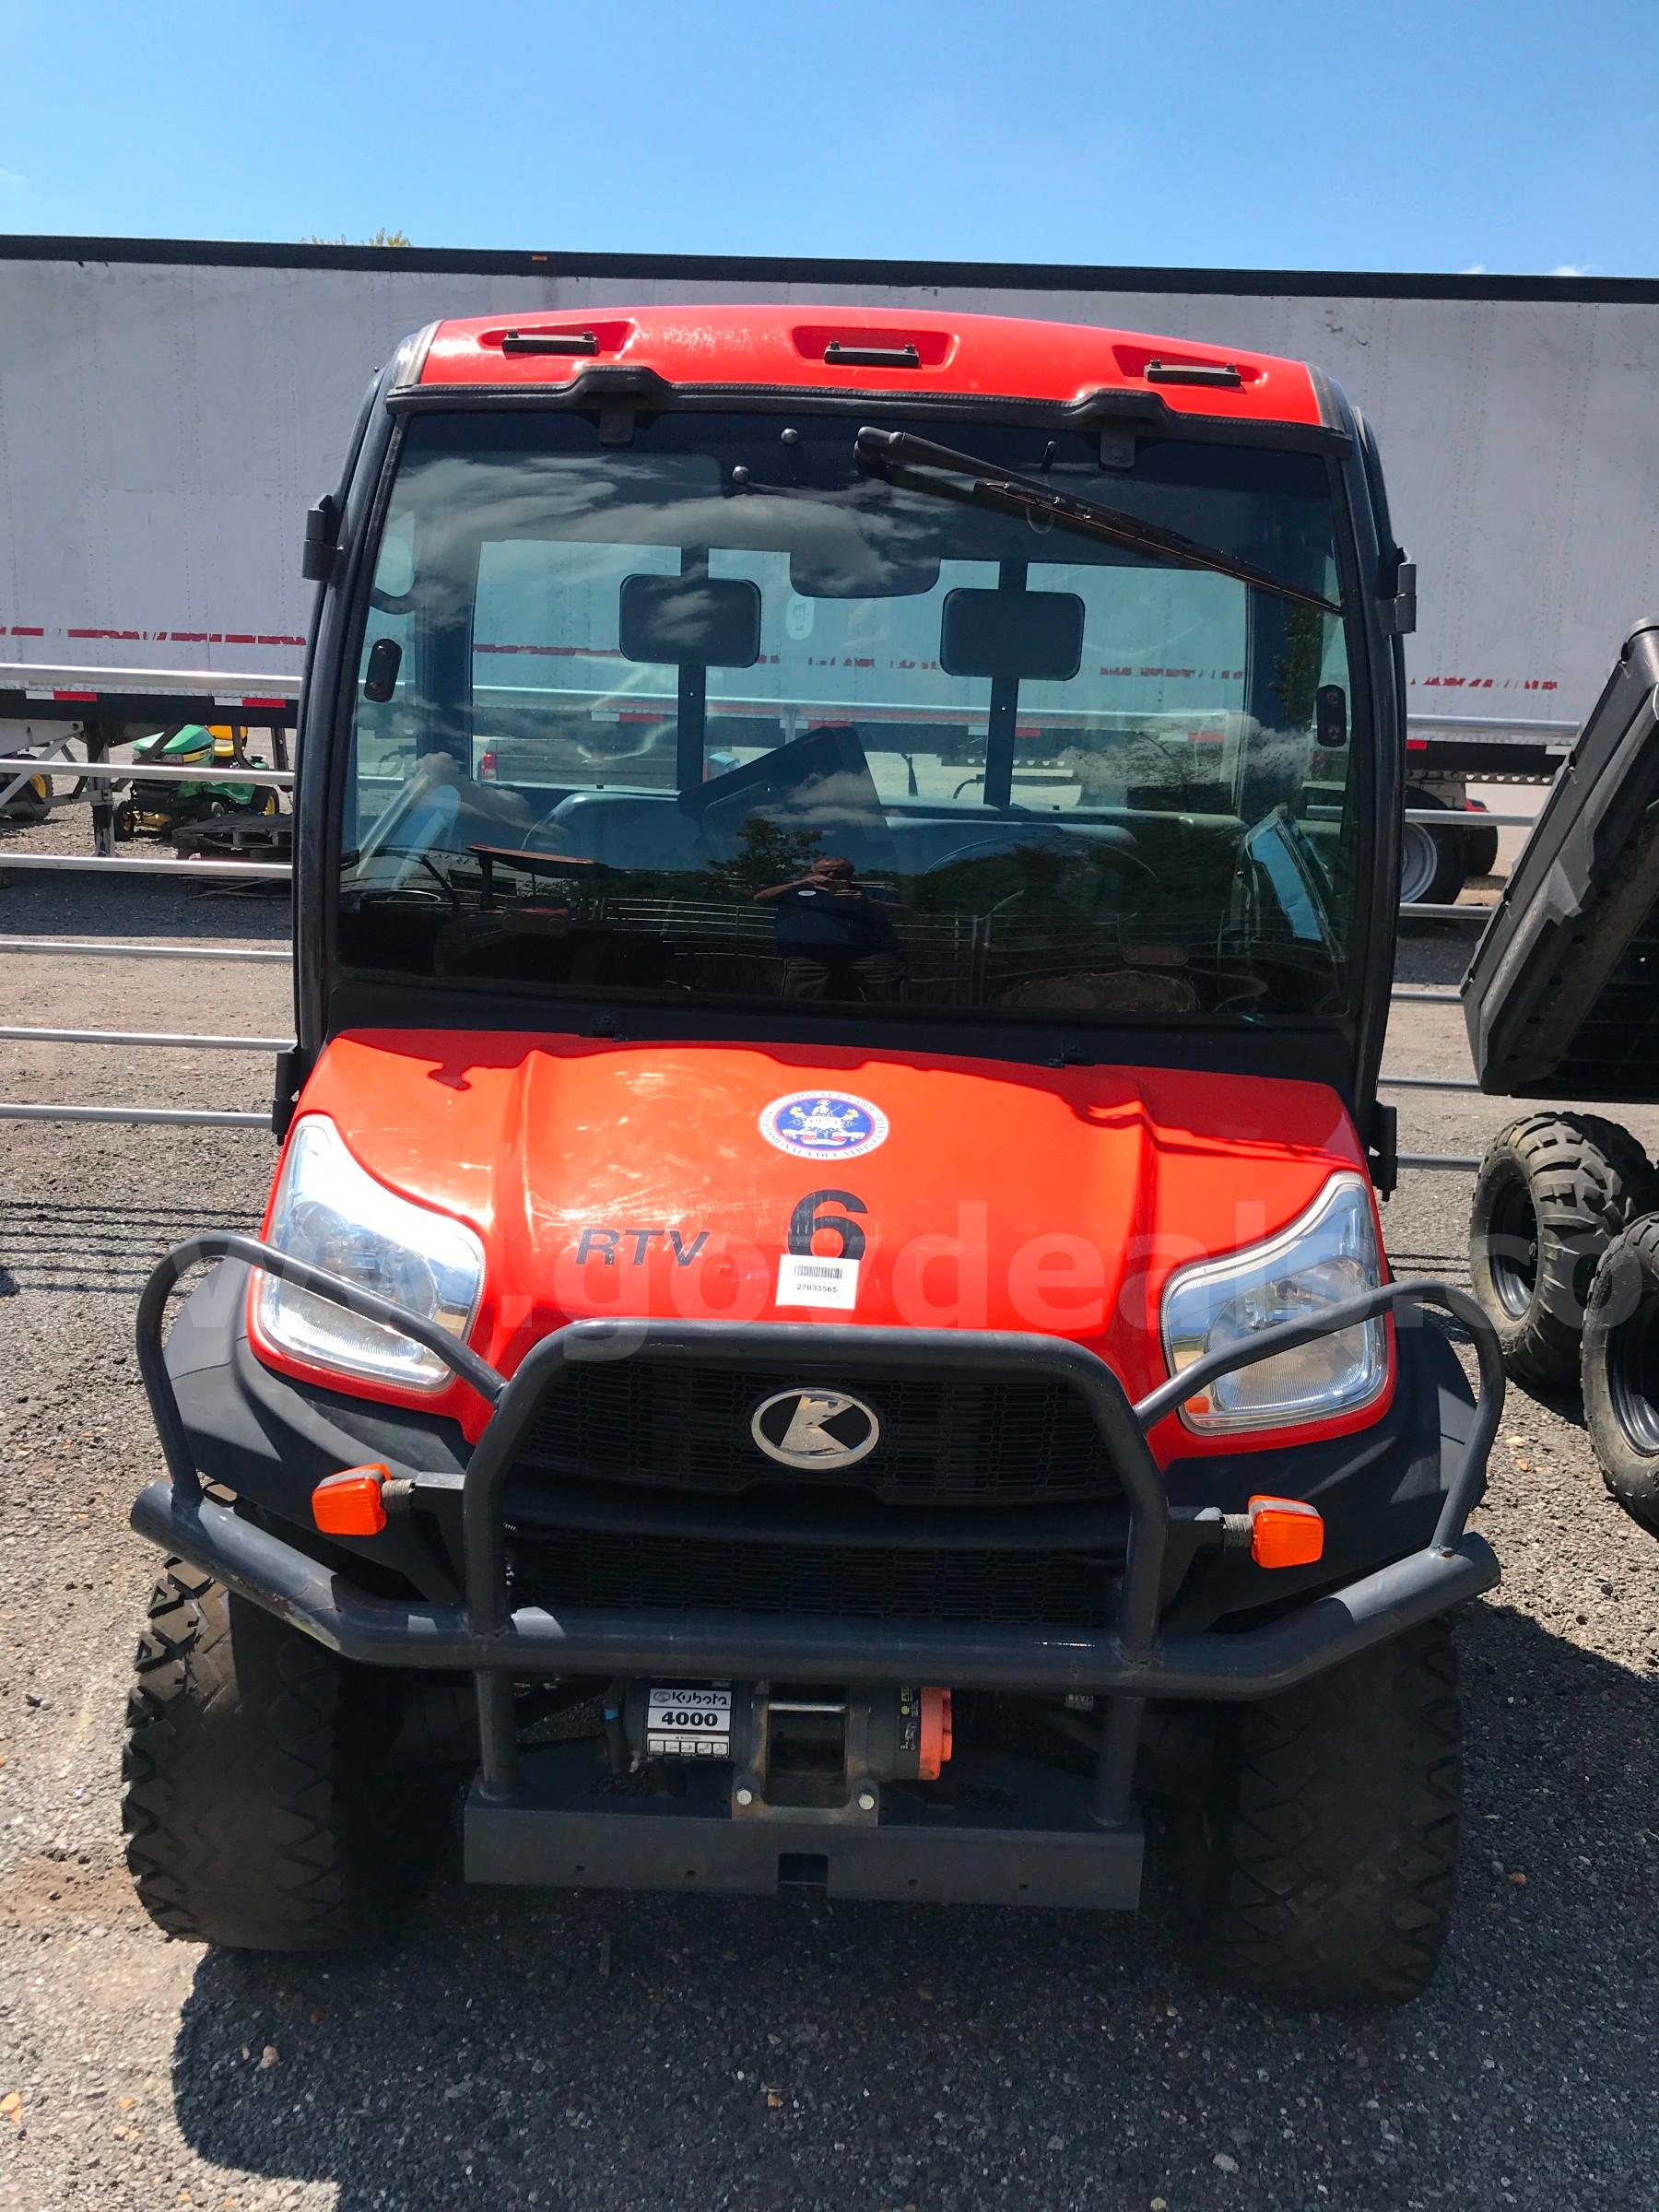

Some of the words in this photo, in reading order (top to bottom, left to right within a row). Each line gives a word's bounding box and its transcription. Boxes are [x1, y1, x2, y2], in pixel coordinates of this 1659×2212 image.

[786, 1189, 869, 1260] 6
[575, 1228, 712, 1268] RTV
[796, 1283, 839, 1293] 27033565
[671, 1690, 728, 1705] Kubota
[661, 1711, 719, 1727] 4000
